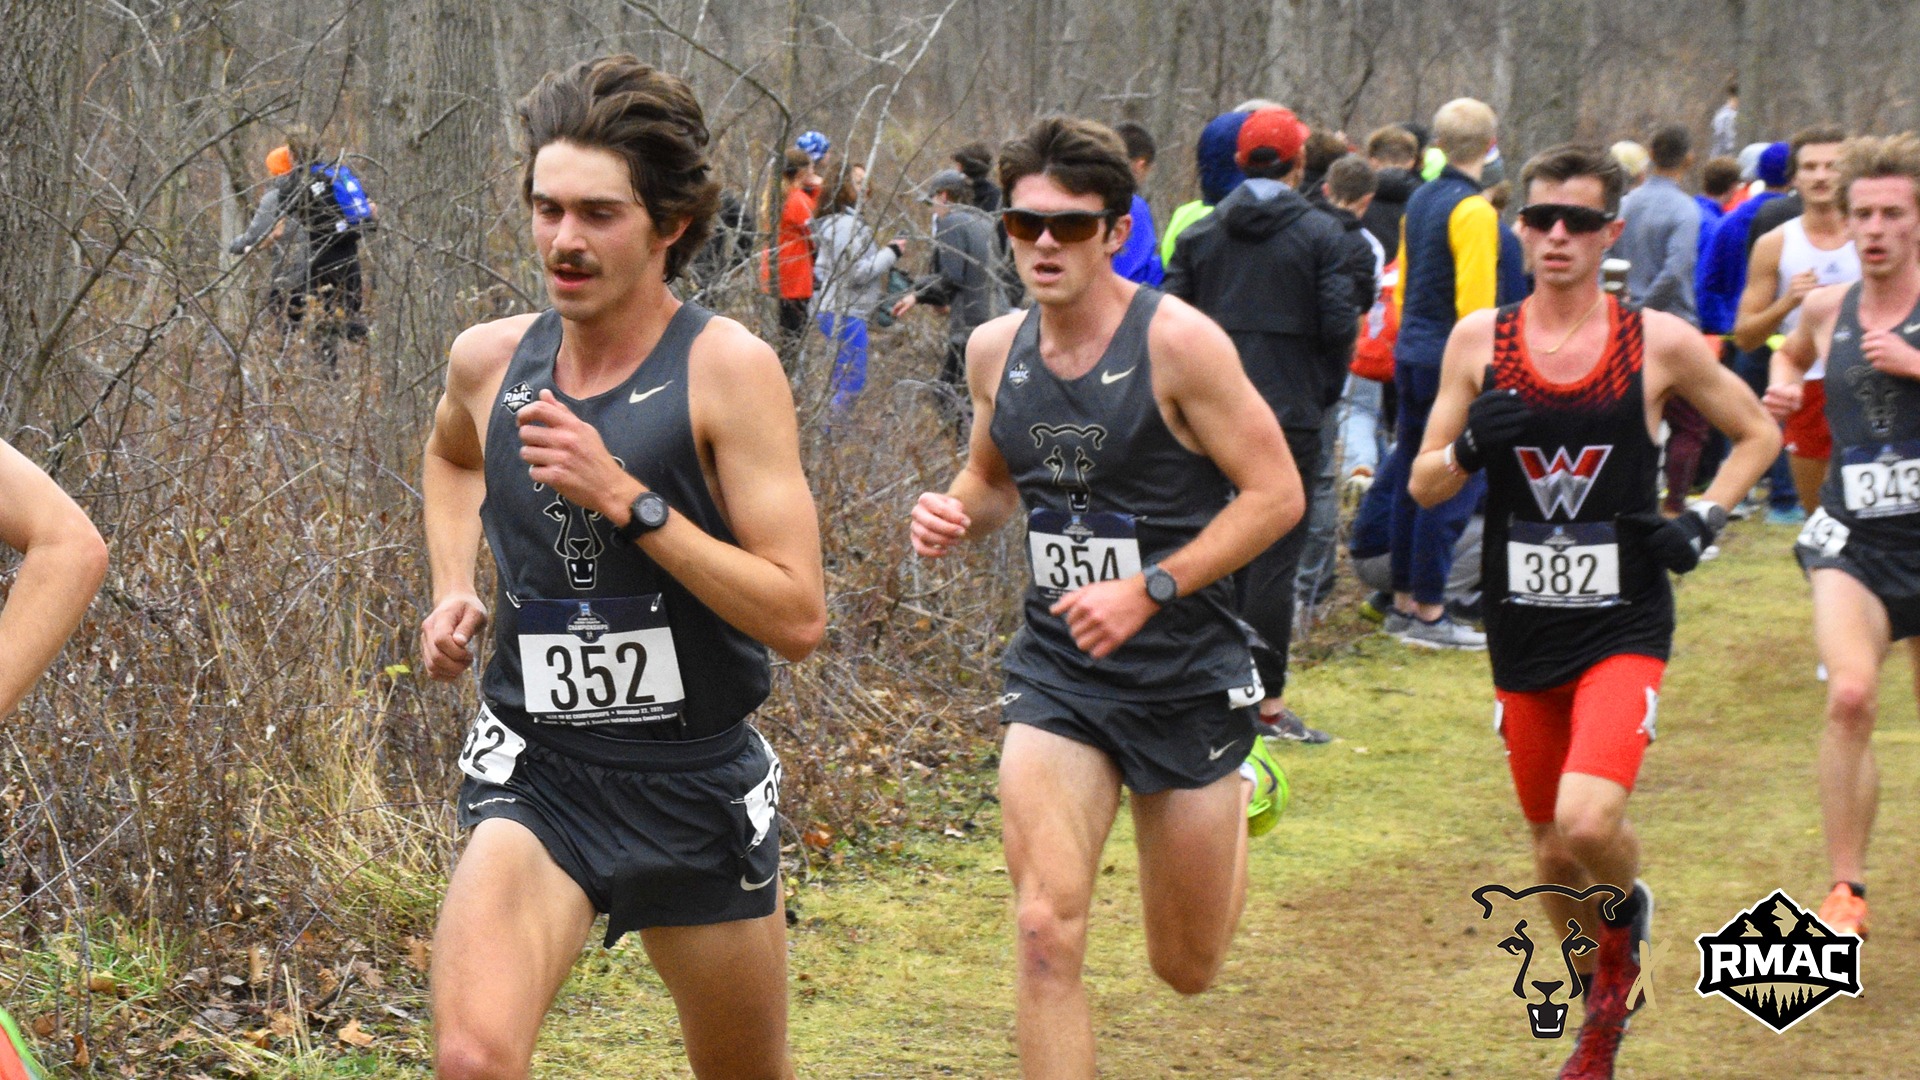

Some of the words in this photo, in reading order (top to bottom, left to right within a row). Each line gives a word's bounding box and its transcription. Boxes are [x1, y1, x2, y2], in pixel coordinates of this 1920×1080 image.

[503, 391, 532, 403] RMAC
[1513, 444, 1614, 520] W
[1860, 466, 1920, 508] 343
[1045, 542, 1120, 588] 354
[1525, 552, 1599, 595] 382
[546, 641, 656, 711] 352
